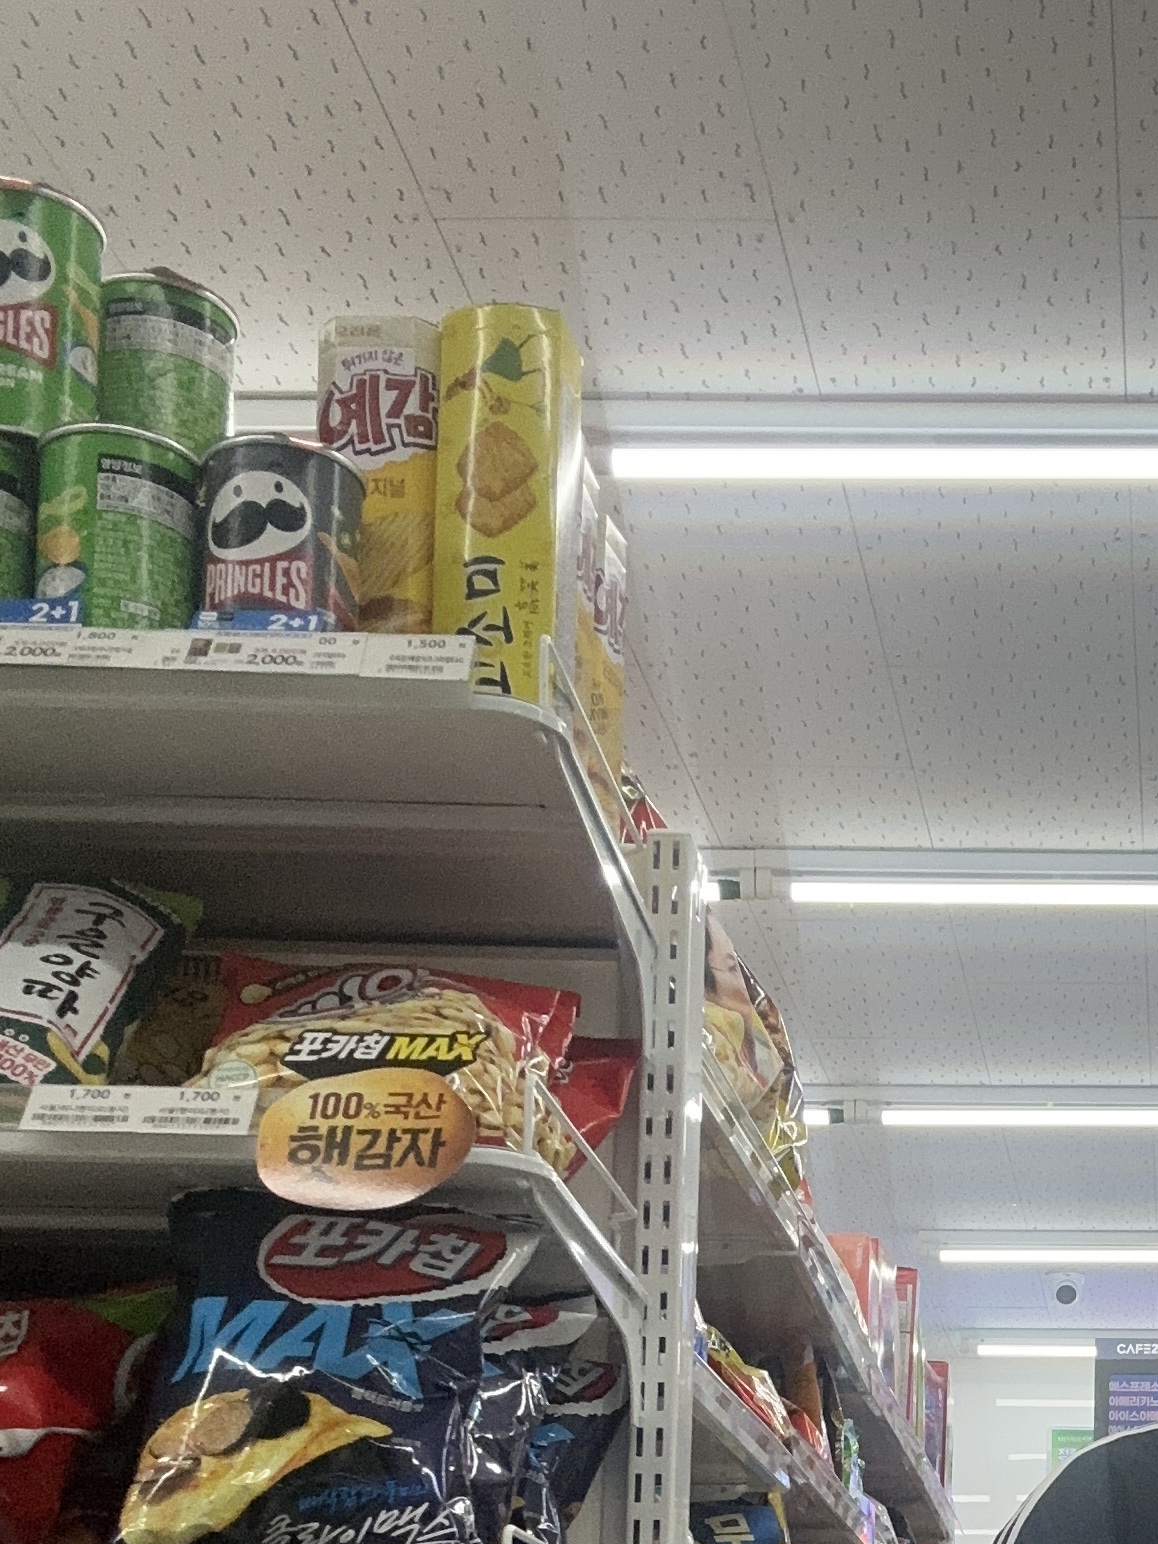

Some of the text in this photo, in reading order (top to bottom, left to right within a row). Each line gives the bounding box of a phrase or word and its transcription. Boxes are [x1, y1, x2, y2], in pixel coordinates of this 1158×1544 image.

[319, 370, 438, 447] 예감
[206, 560, 307, 610] PRINGLES
[29, 601, 79, 622] 2+1
[269, 614, 318, 631] 2+1
[284, 1032, 489, 1062] 포카칩 MAX
[69, 1089, 111, 1100] 1,700
[178, 1090, 221, 1102] 1,700
[383, 1092, 447, 1121] 국산
[270, 1222, 481, 1282] 포카칩
[172, 1296, 476, 1400] MAX
